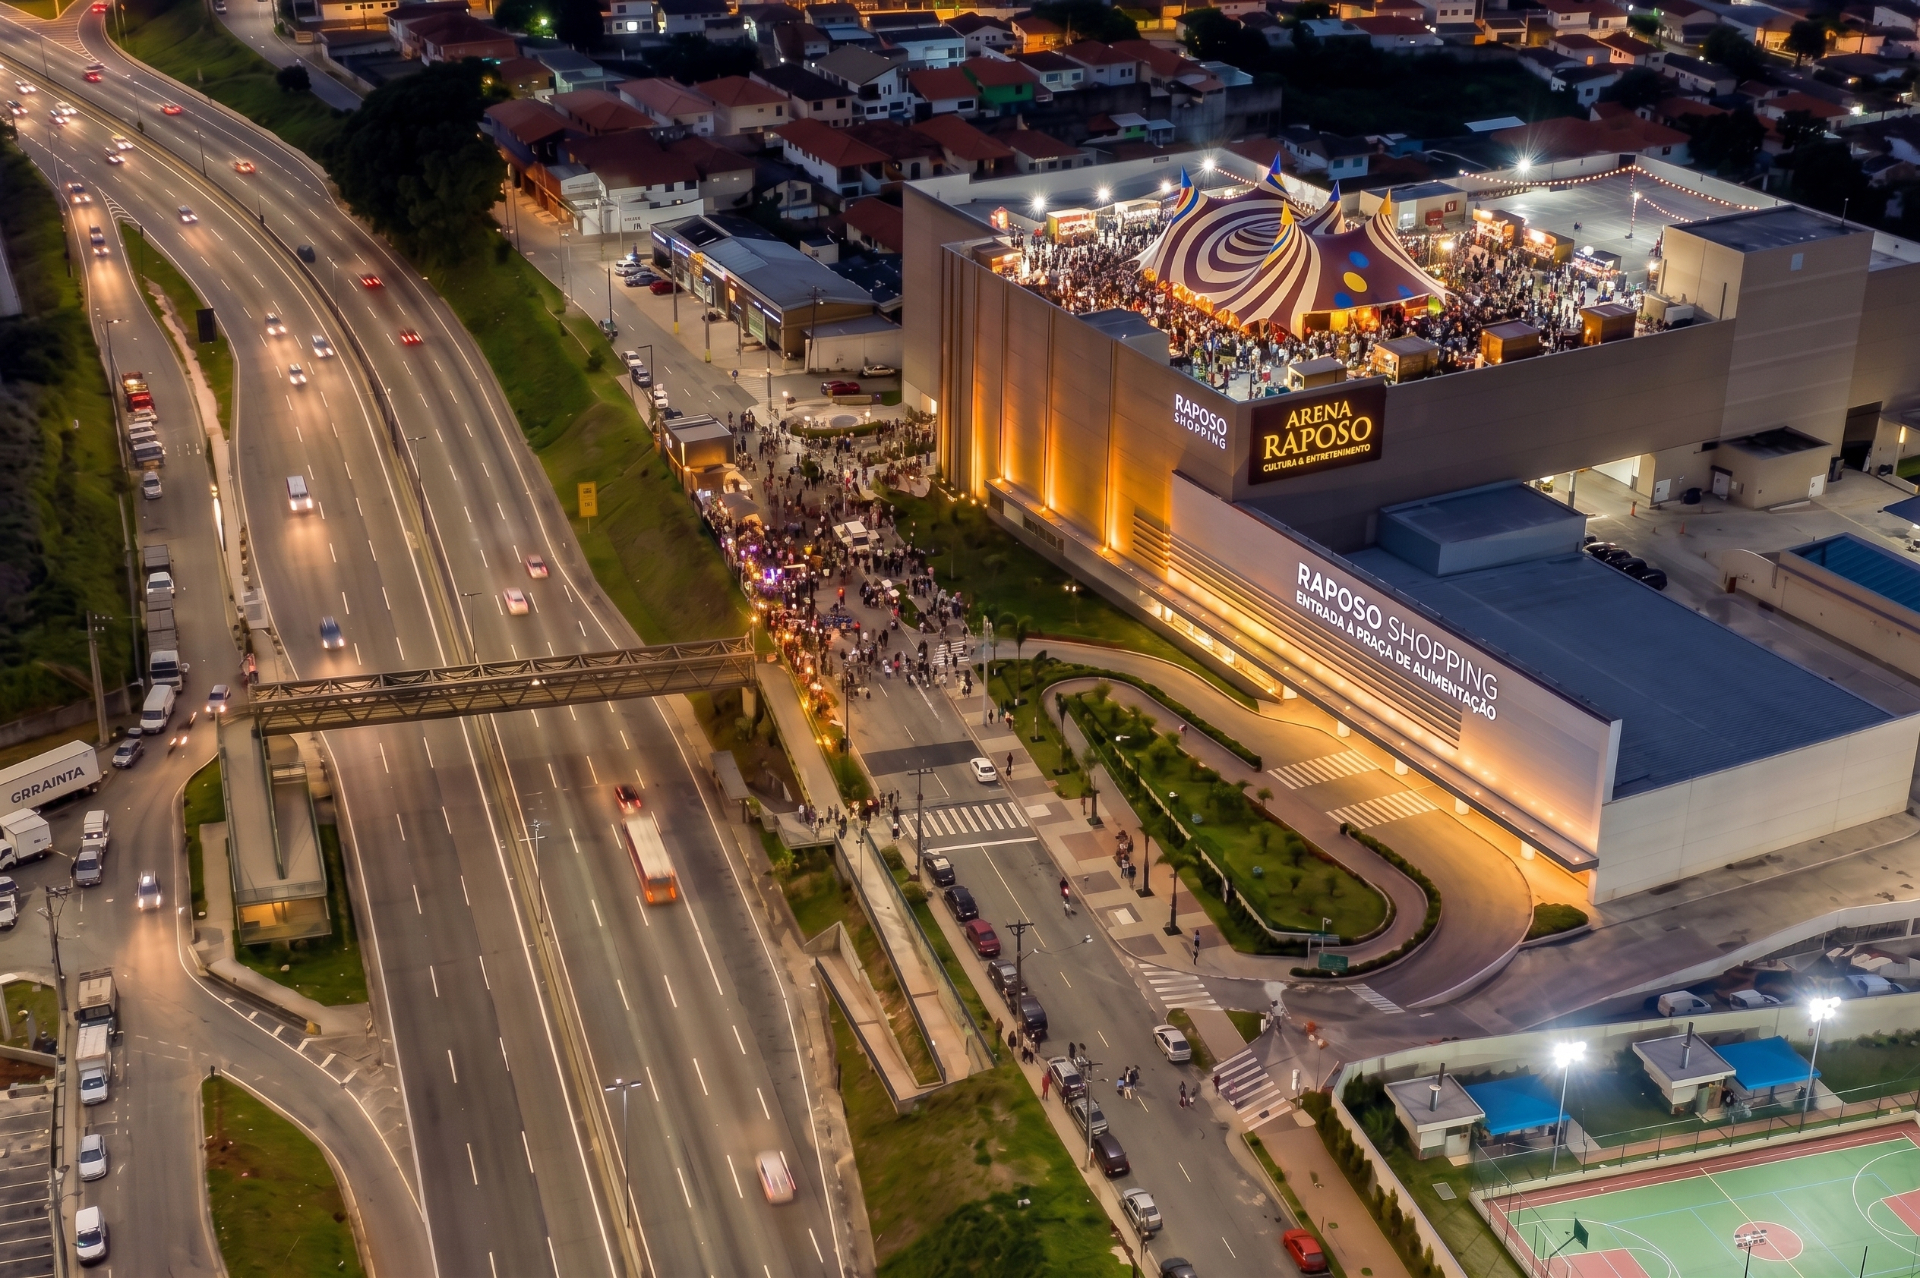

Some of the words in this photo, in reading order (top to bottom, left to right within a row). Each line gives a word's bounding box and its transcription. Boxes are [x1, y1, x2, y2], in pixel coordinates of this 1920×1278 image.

[1174, 412, 1226, 449] SHOPPING
[1175, 394, 1227, 436] RAPOSO
[1285, 400, 1353, 429] ARENA
[1263, 416, 1372, 459] RAPOSO
[1263, 457, 1297, 472] CULTURA
[1298, 456, 1305, 466] &
[1297, 562, 1382, 630] RAPOSO
[1388, 616, 1498, 700] SHOPPING
[1296, 590, 1345, 630] ENTRADA
[1346, 619, 1354, 637] À
[1356, 625, 1394, 661] PRAÇA
[1395, 650, 1411, 670] DE
[1413, 661, 1496, 721] ALIMENTAÇÃO
[11, 766, 85, 804] GRRAINTA
